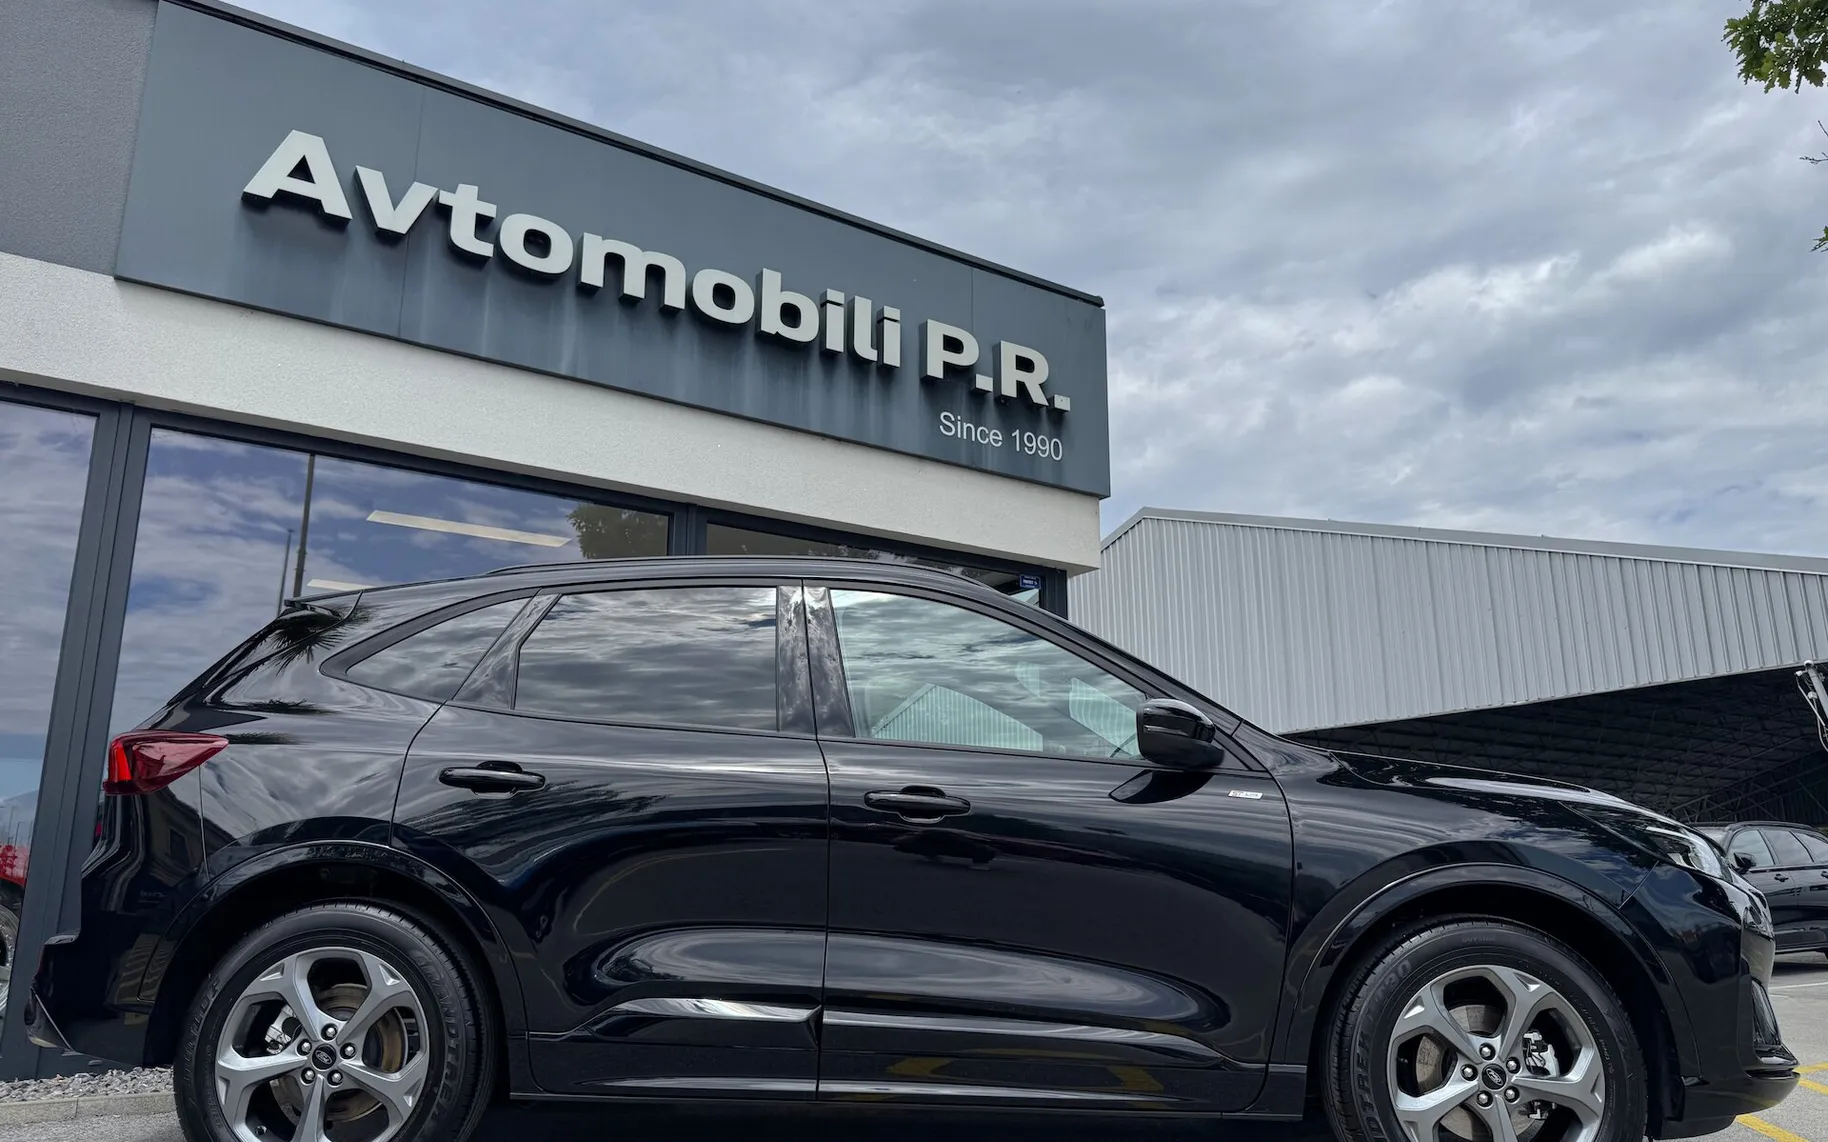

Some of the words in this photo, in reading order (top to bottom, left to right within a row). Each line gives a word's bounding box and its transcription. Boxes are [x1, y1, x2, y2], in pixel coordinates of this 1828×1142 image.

[242, 129, 901, 368] Avtomobili
[925, 319, 1071, 412] P.R.
[938, 410, 1003, 448] Since
[1011, 428, 1063, 461] 1990
